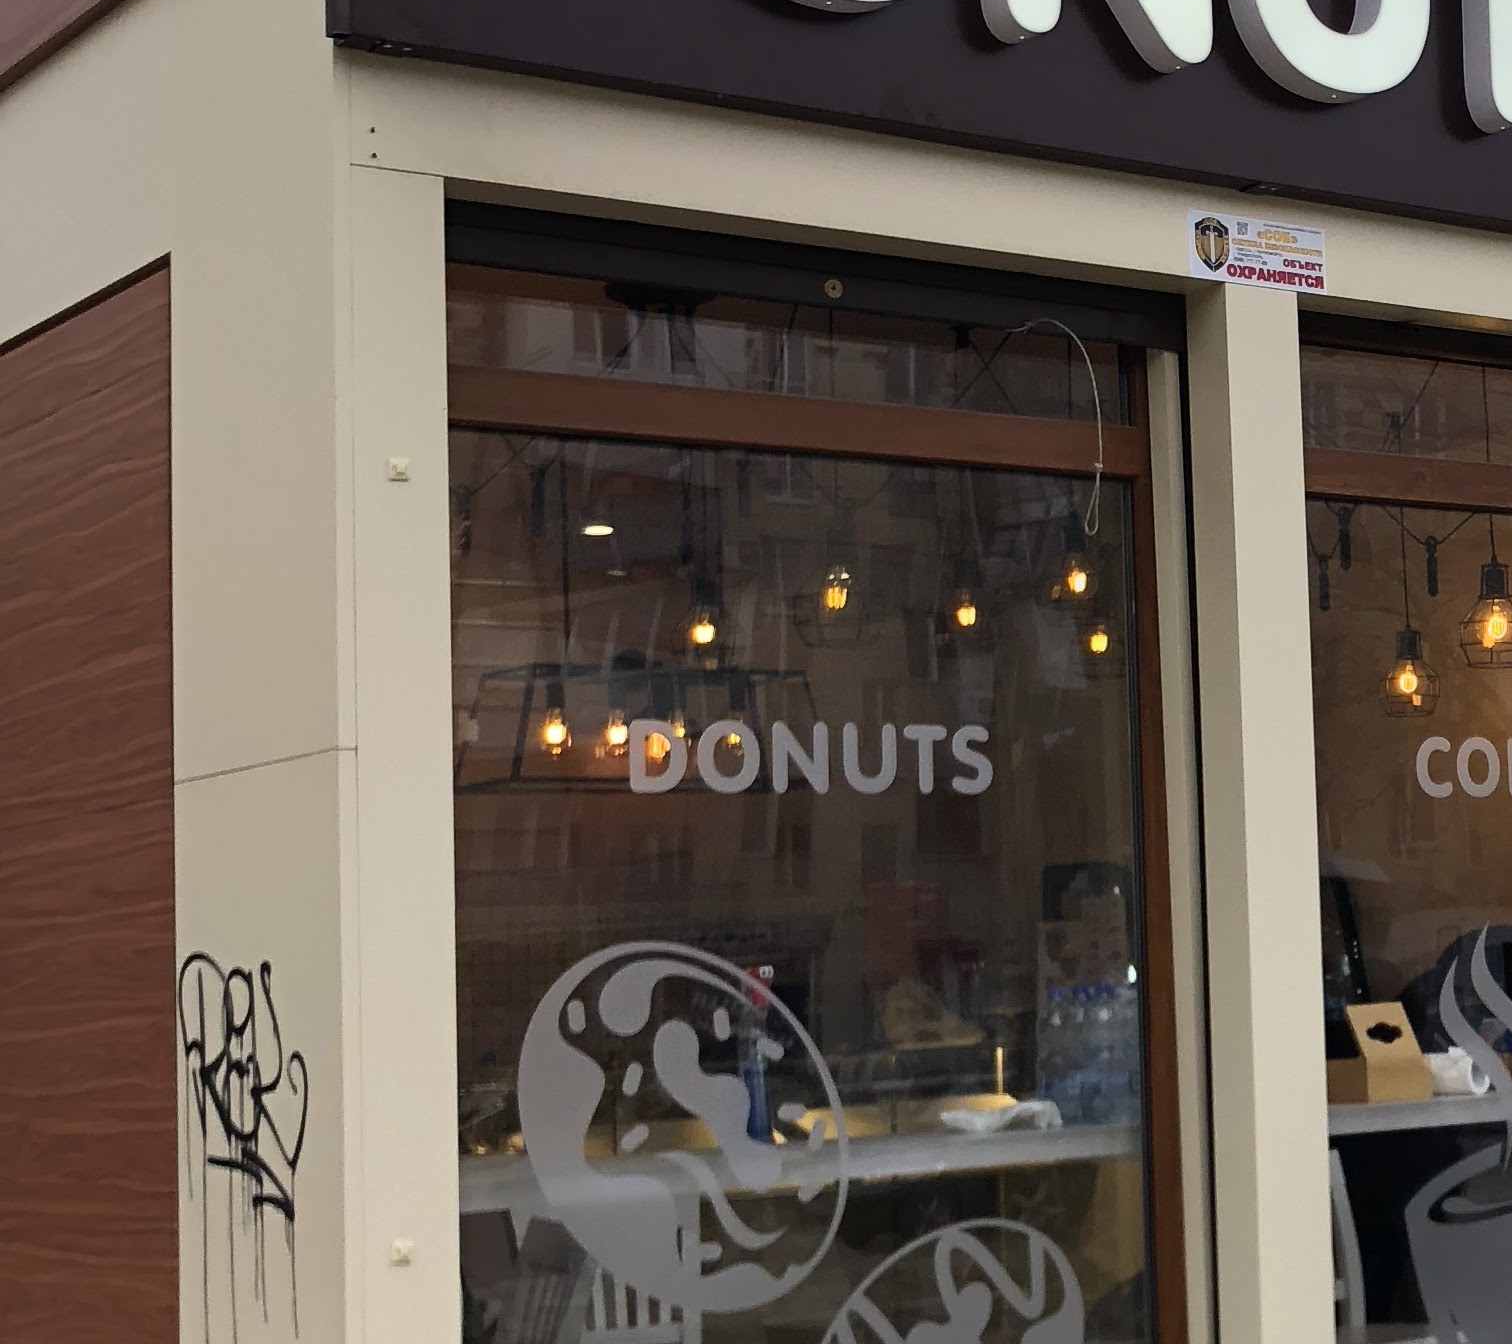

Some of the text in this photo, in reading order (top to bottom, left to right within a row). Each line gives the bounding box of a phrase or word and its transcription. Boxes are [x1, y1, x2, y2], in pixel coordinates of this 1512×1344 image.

[1226, 263, 1325, 290] ОХРАНЯЕТСЯ
[1282, 258, 1324, 273] ОБЪЕКТ
[627, 718, 994, 796] DONUTS
